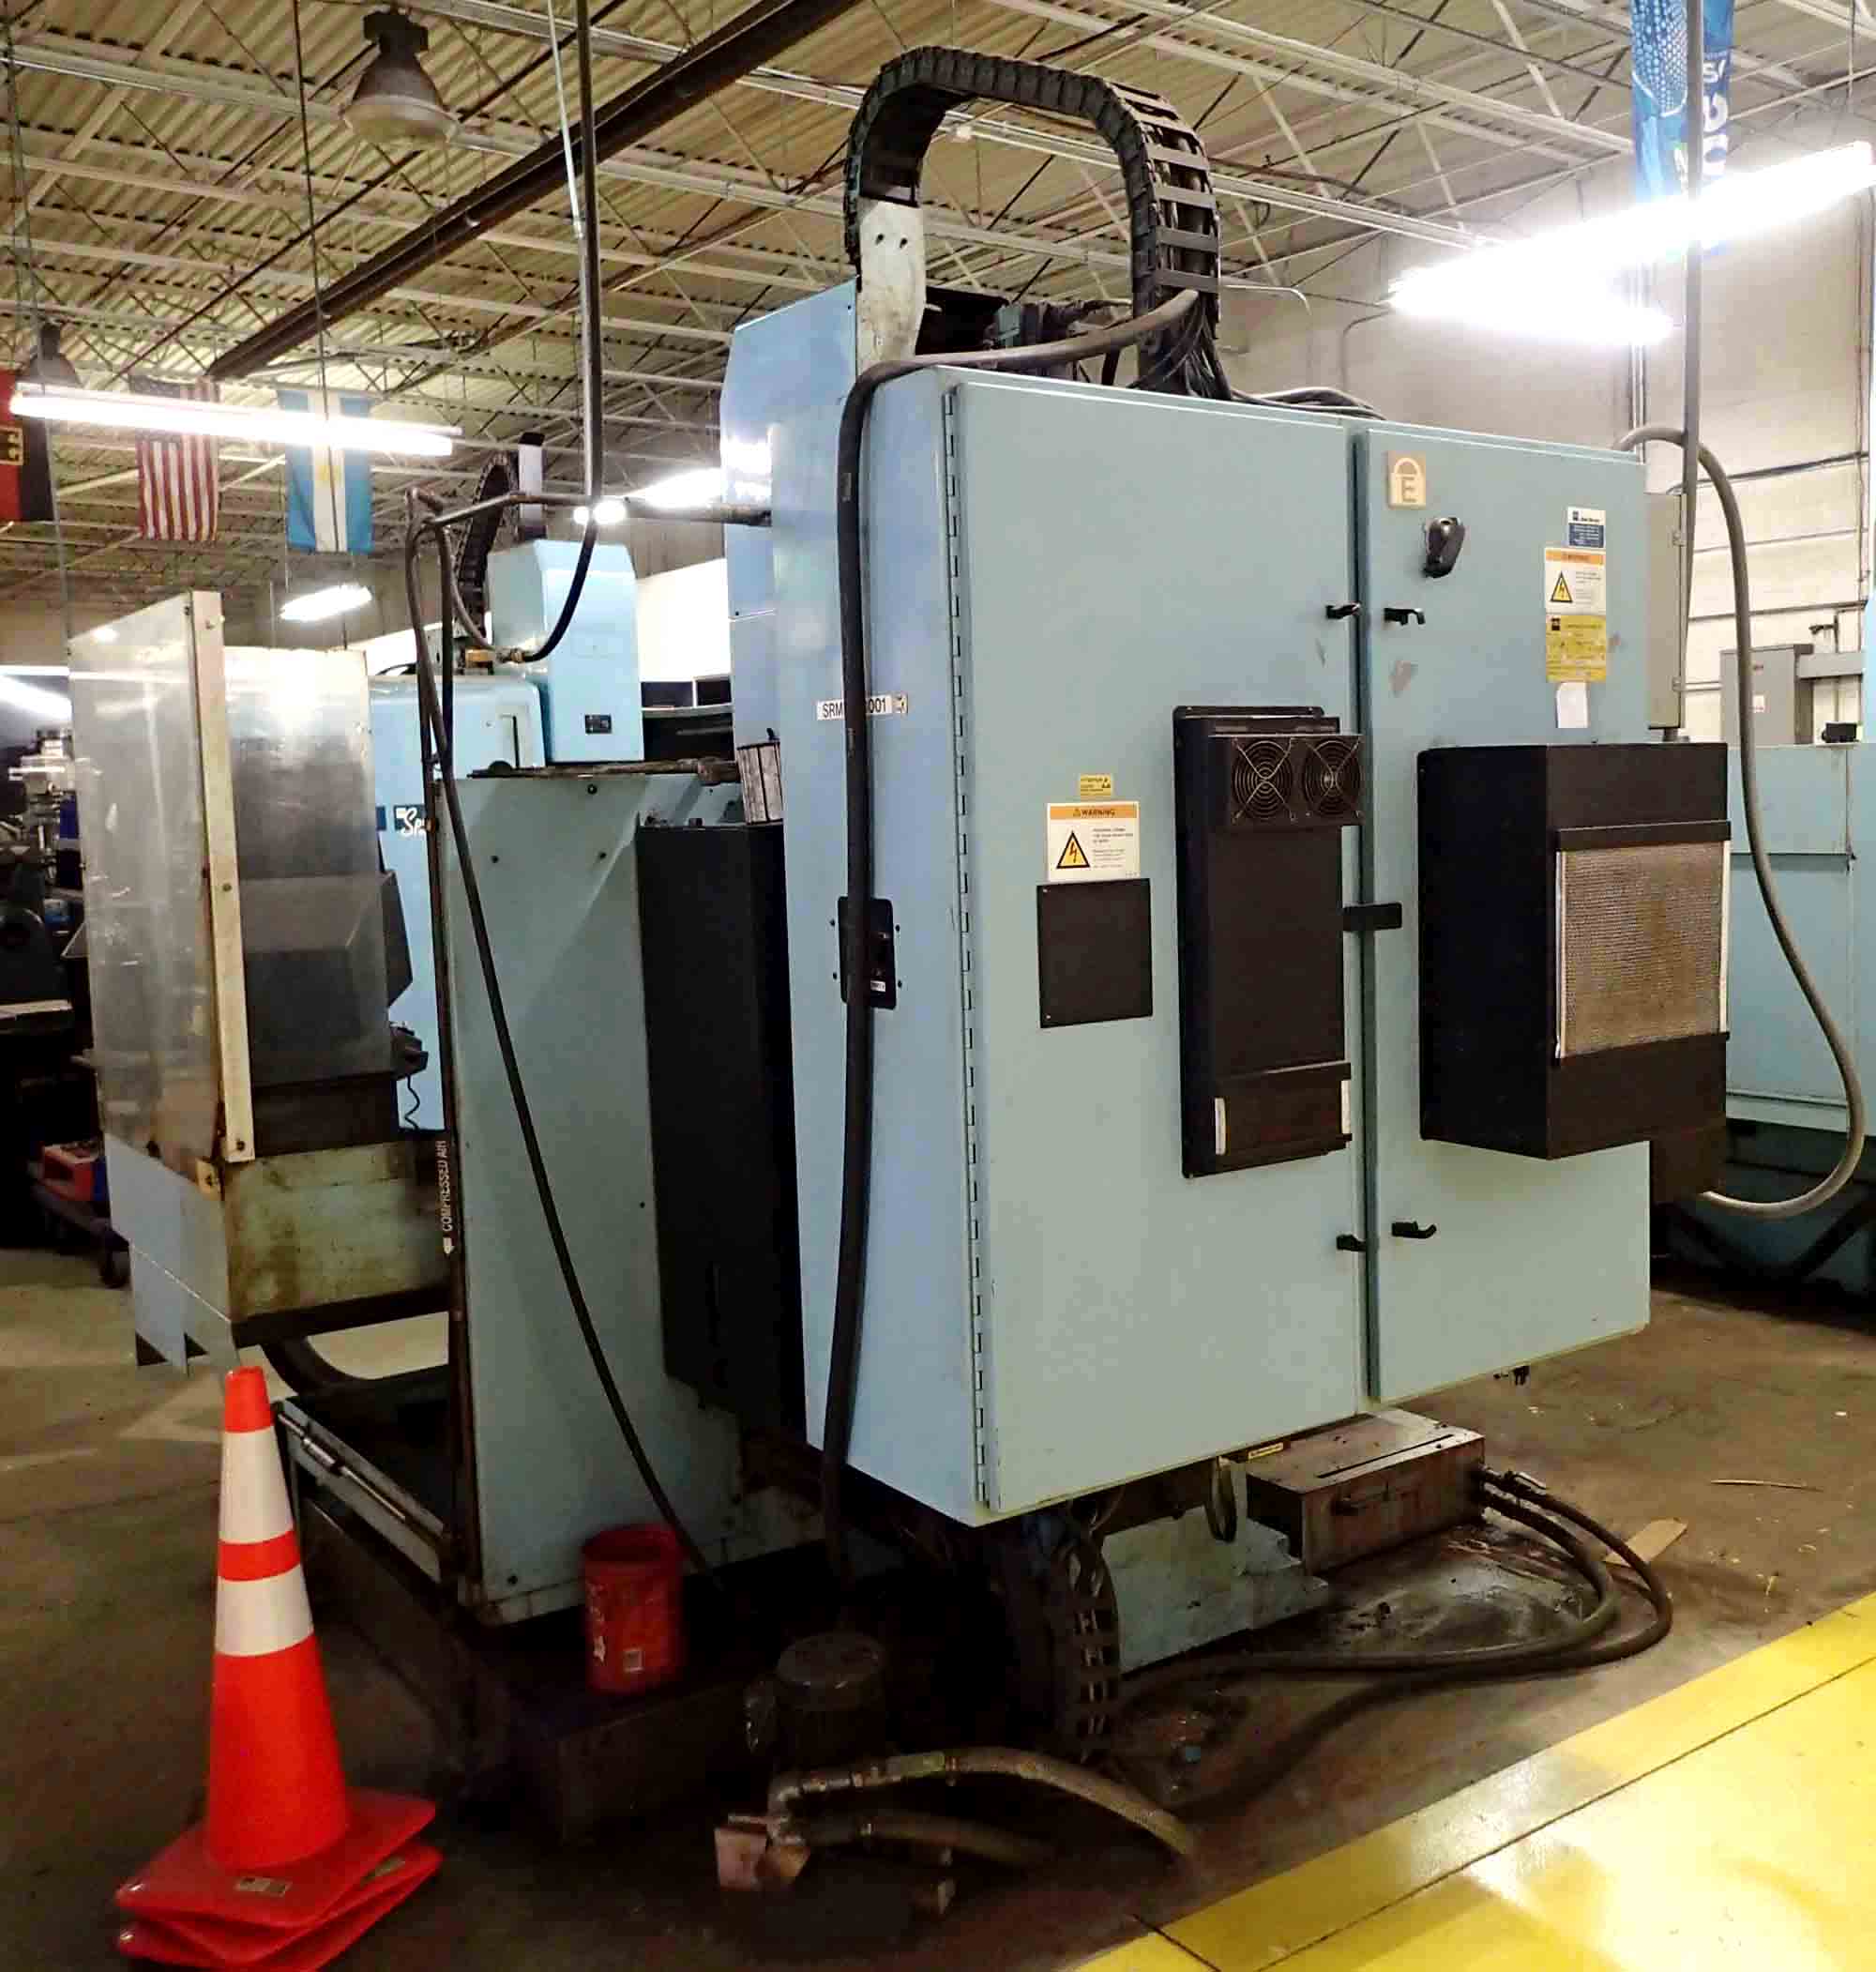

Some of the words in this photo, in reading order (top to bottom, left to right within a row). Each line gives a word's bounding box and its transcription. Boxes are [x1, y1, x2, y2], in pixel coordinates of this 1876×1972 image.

[1082, 809, 1116, 817] WARNING
[435, 1140, 448, 1159] AIR
[437, 1160, 454, 1232] COMPRESSED
